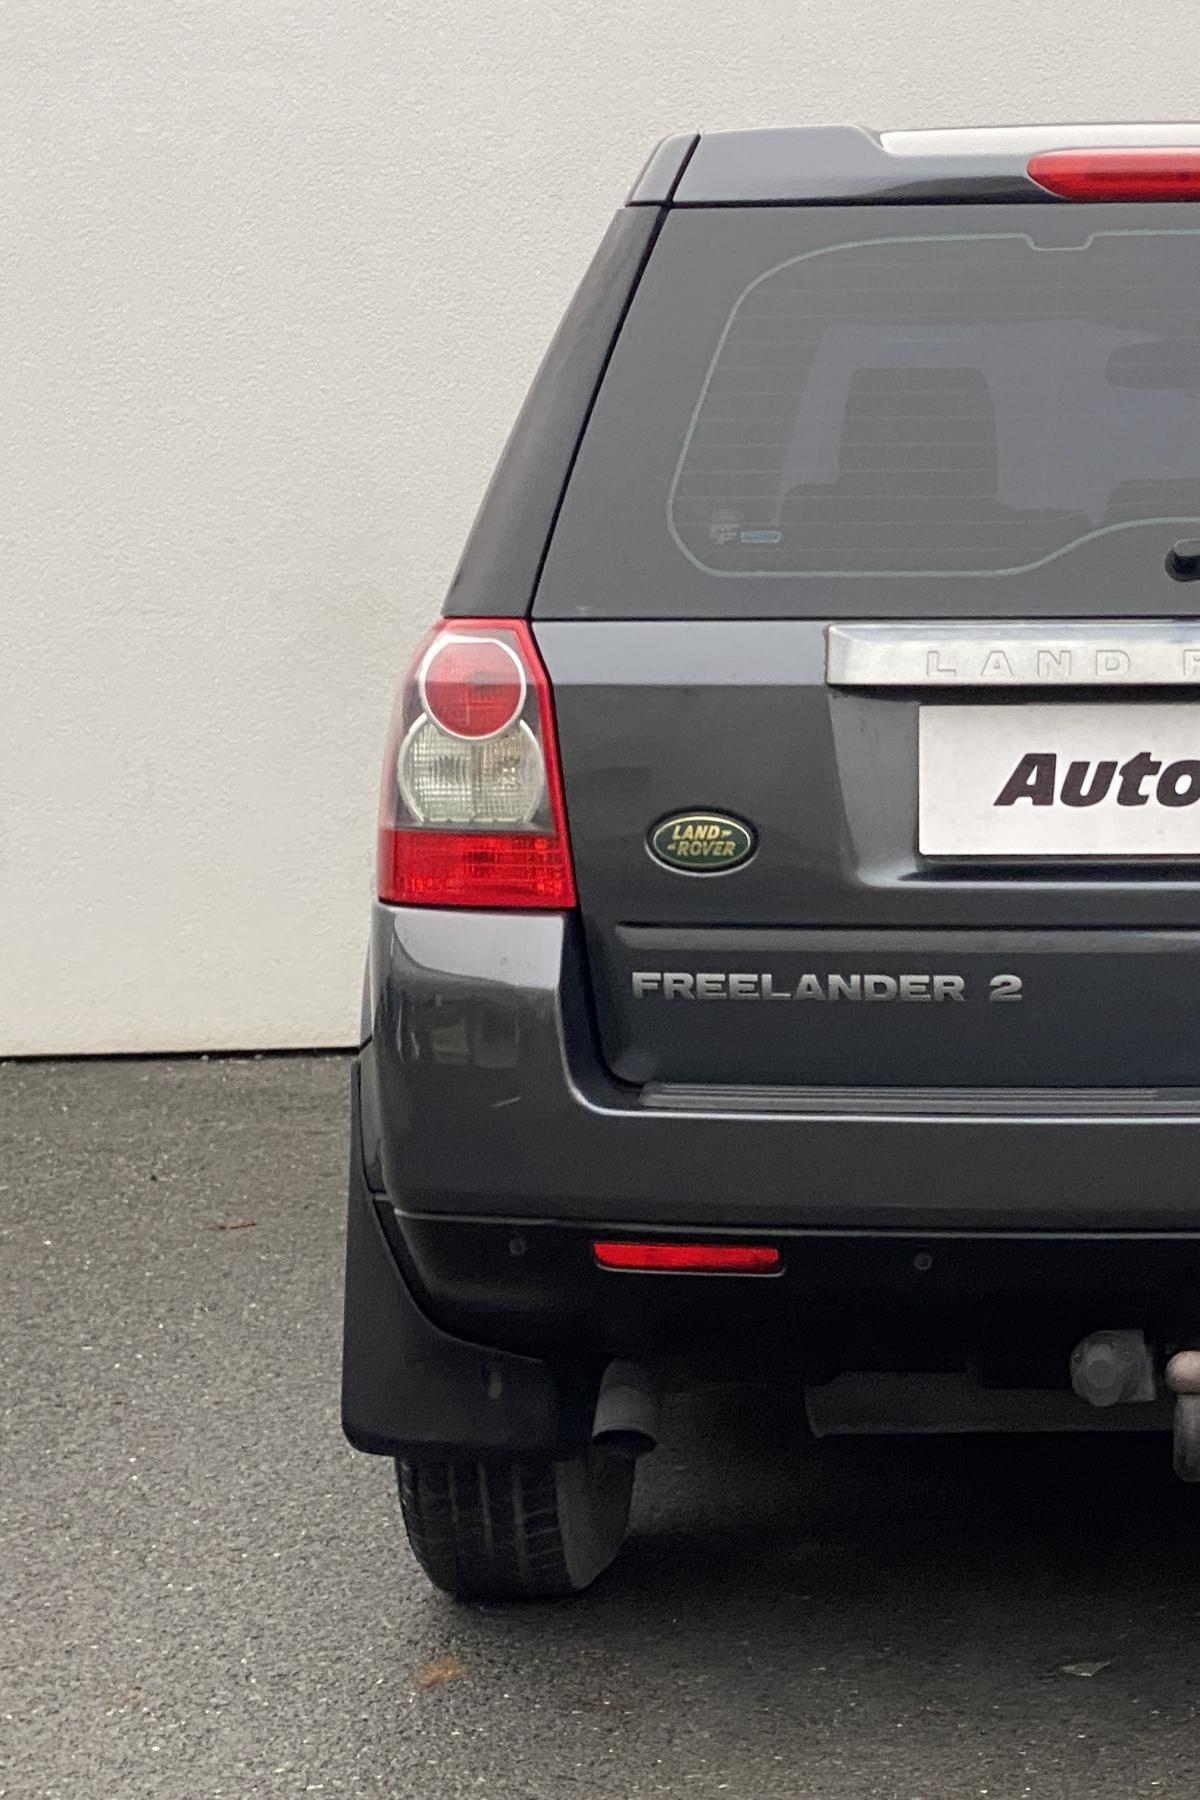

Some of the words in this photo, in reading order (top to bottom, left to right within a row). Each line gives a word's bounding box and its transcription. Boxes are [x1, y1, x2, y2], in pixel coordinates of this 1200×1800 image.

[926, 648, 1132, 677] LAND
[676, 841, 736, 856] ROVER
[632, 971, 966, 1001] FREELANDER
[989, 974, 1023, 1001] 2
